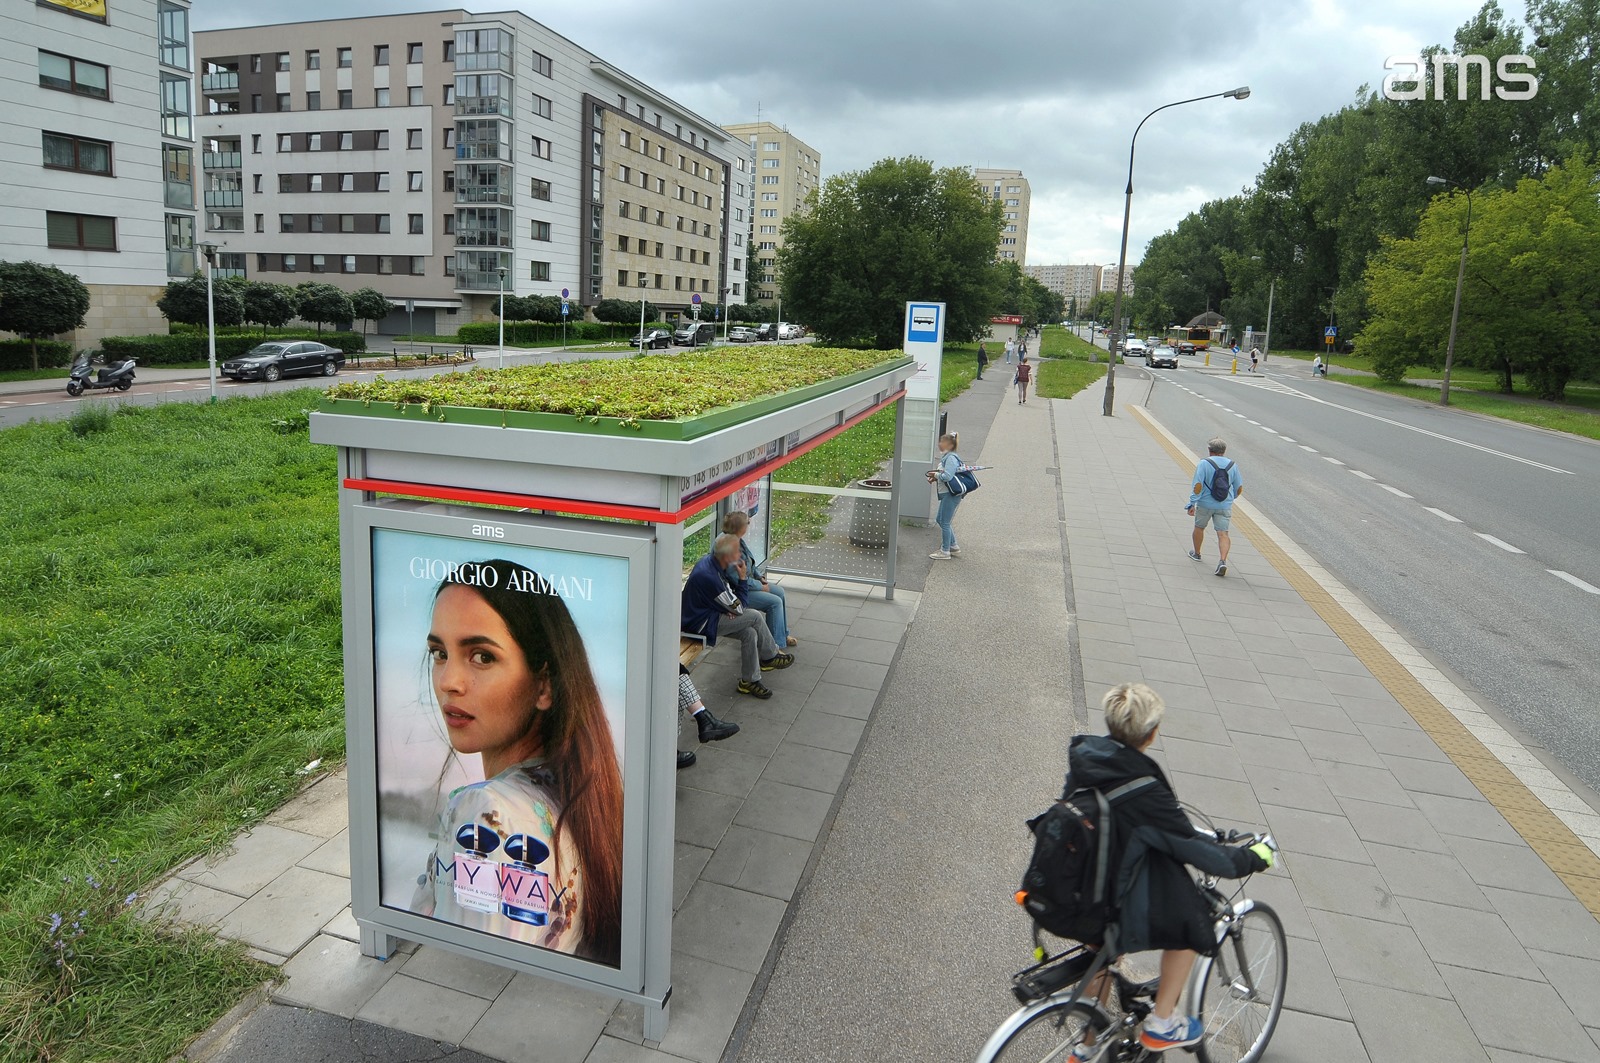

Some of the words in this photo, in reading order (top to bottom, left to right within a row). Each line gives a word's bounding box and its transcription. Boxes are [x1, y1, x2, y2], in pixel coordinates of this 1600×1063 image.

[694, 471, 706, 486] 148
[472, 524, 505, 539] ams
[409, 556, 499, 588] GIORGIO
[506, 568, 593, 601] ARMANI
[436, 856, 481, 885] MY
[495, 869, 567, 906] WAY
[524, 901, 545, 910] PARFUM
